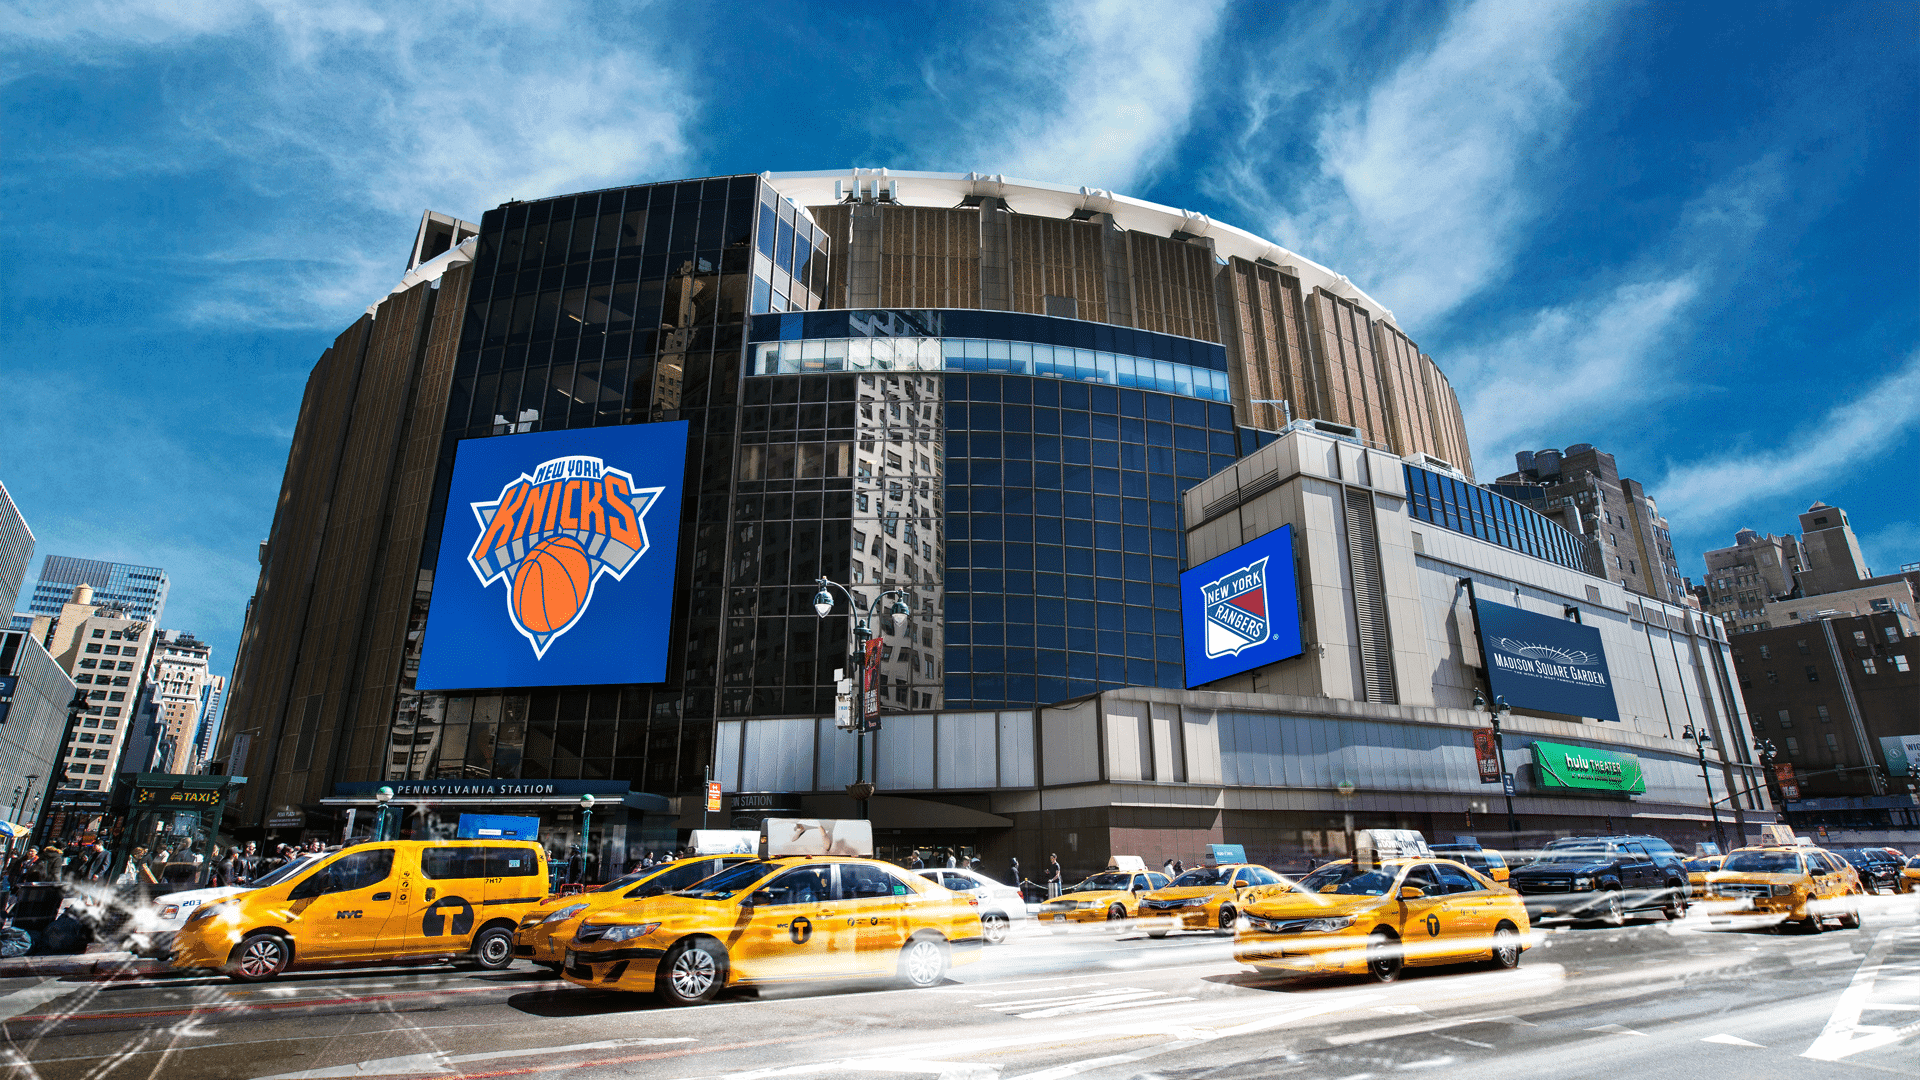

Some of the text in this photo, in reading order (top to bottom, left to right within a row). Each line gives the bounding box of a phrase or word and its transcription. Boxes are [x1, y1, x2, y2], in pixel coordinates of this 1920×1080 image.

[533, 460, 601, 484] NEW YORK
[475, 475, 643, 561] KNICKS
[1207, 571, 1261, 604] NEW YORK
[1215, 605, 1263, 638] RANGERS
[1494, 653, 1605, 685] MADISON SQUARE GARDEN
[1565, 752, 1622, 773] hulu THEATER
[184, 792, 210, 802] TAXI
[397, 784, 554, 795] PENNSYLVANIA STATION
[741, 795, 773, 807] STATION
[183, 899, 202, 907] 203
[336, 909, 363, 919] NYC
[436, 906, 464, 936] T
